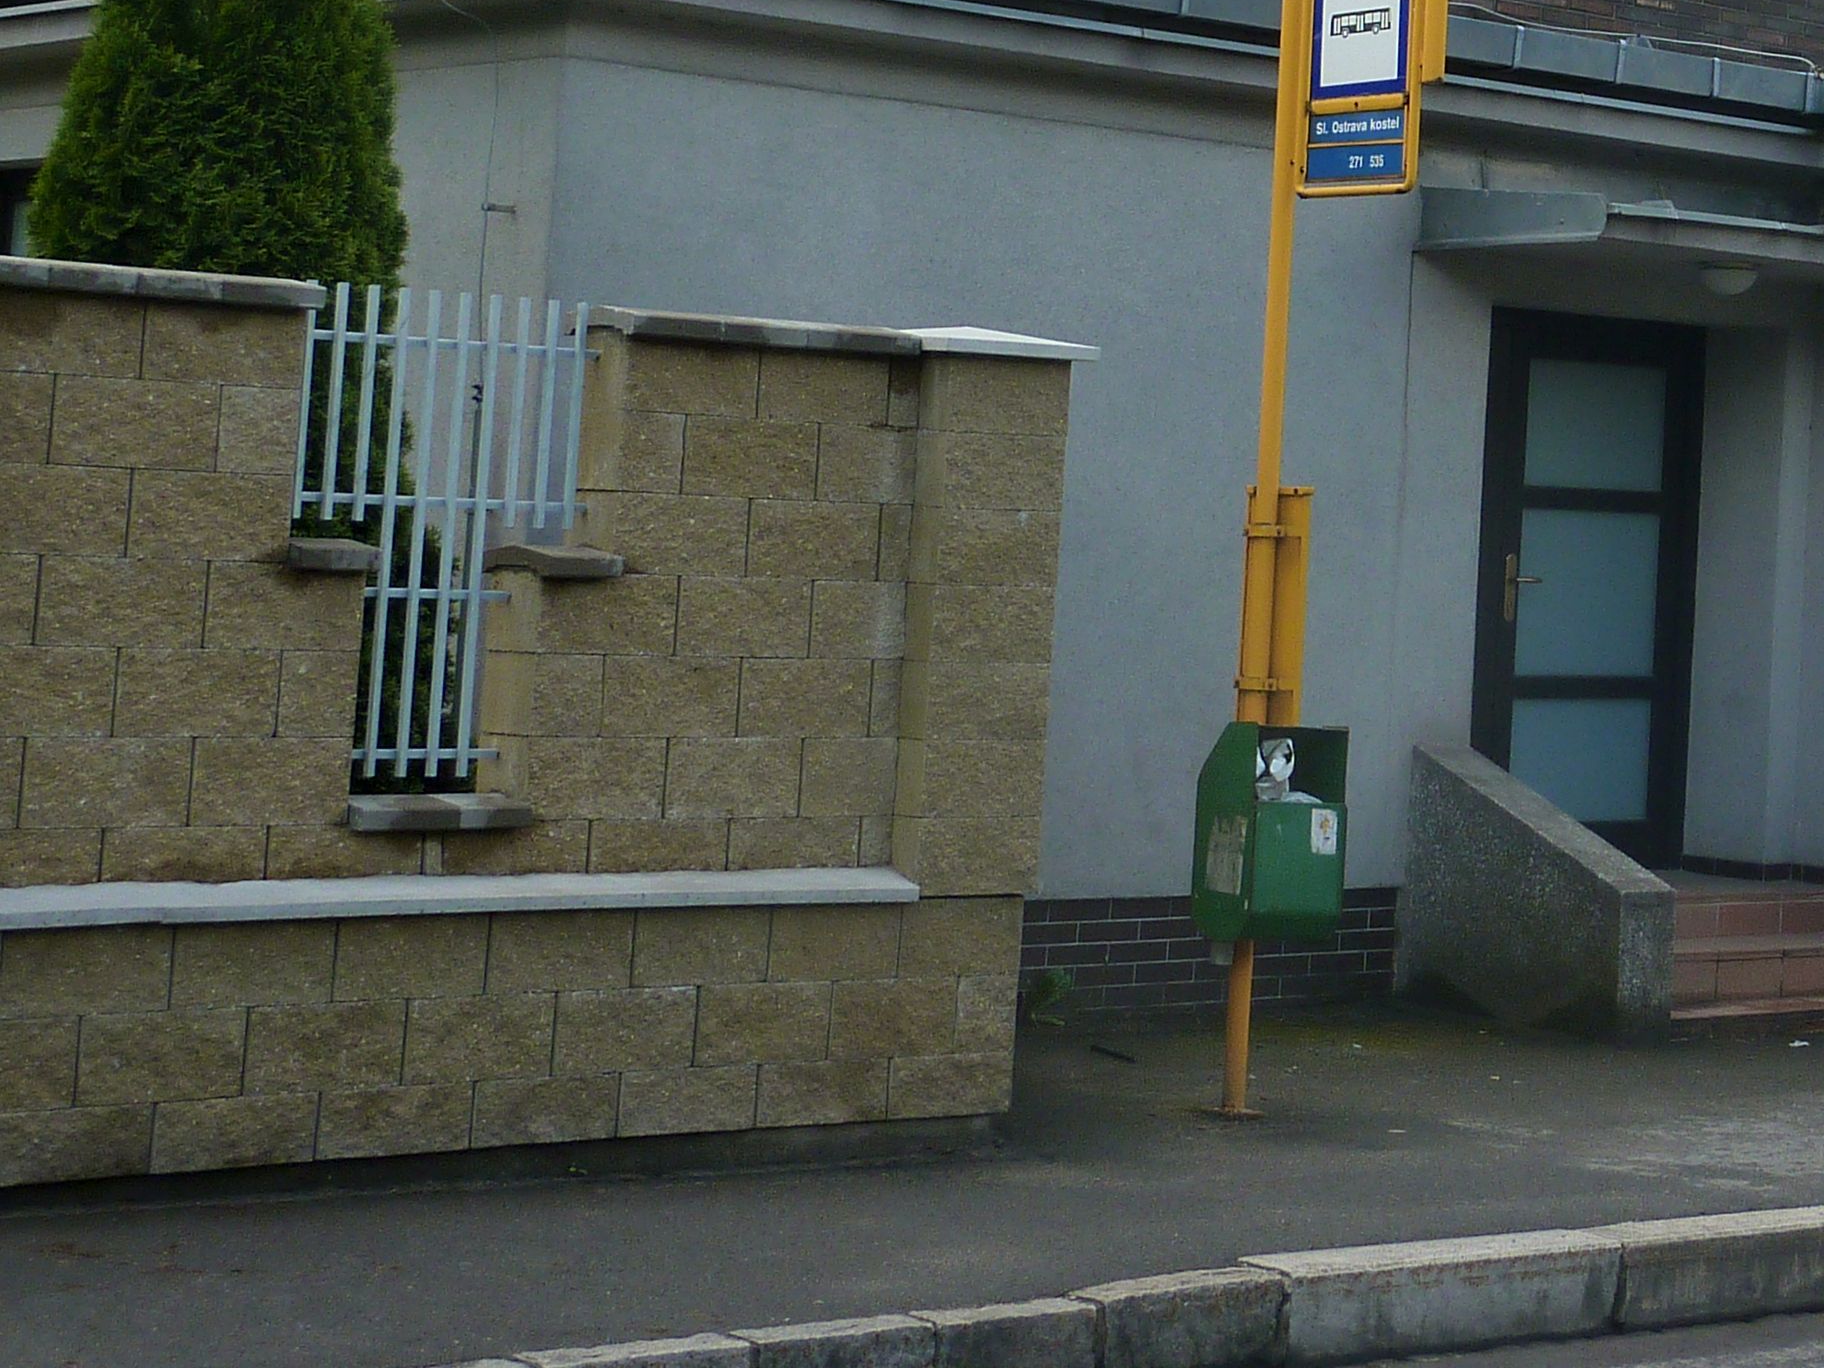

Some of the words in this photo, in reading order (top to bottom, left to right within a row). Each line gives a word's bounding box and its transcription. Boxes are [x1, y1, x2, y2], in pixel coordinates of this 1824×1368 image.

[1332, 120, 1367, 134] Ostrava
[1370, 116, 1400, 131] kostel
[1349, 155, 1363, 169] 271
